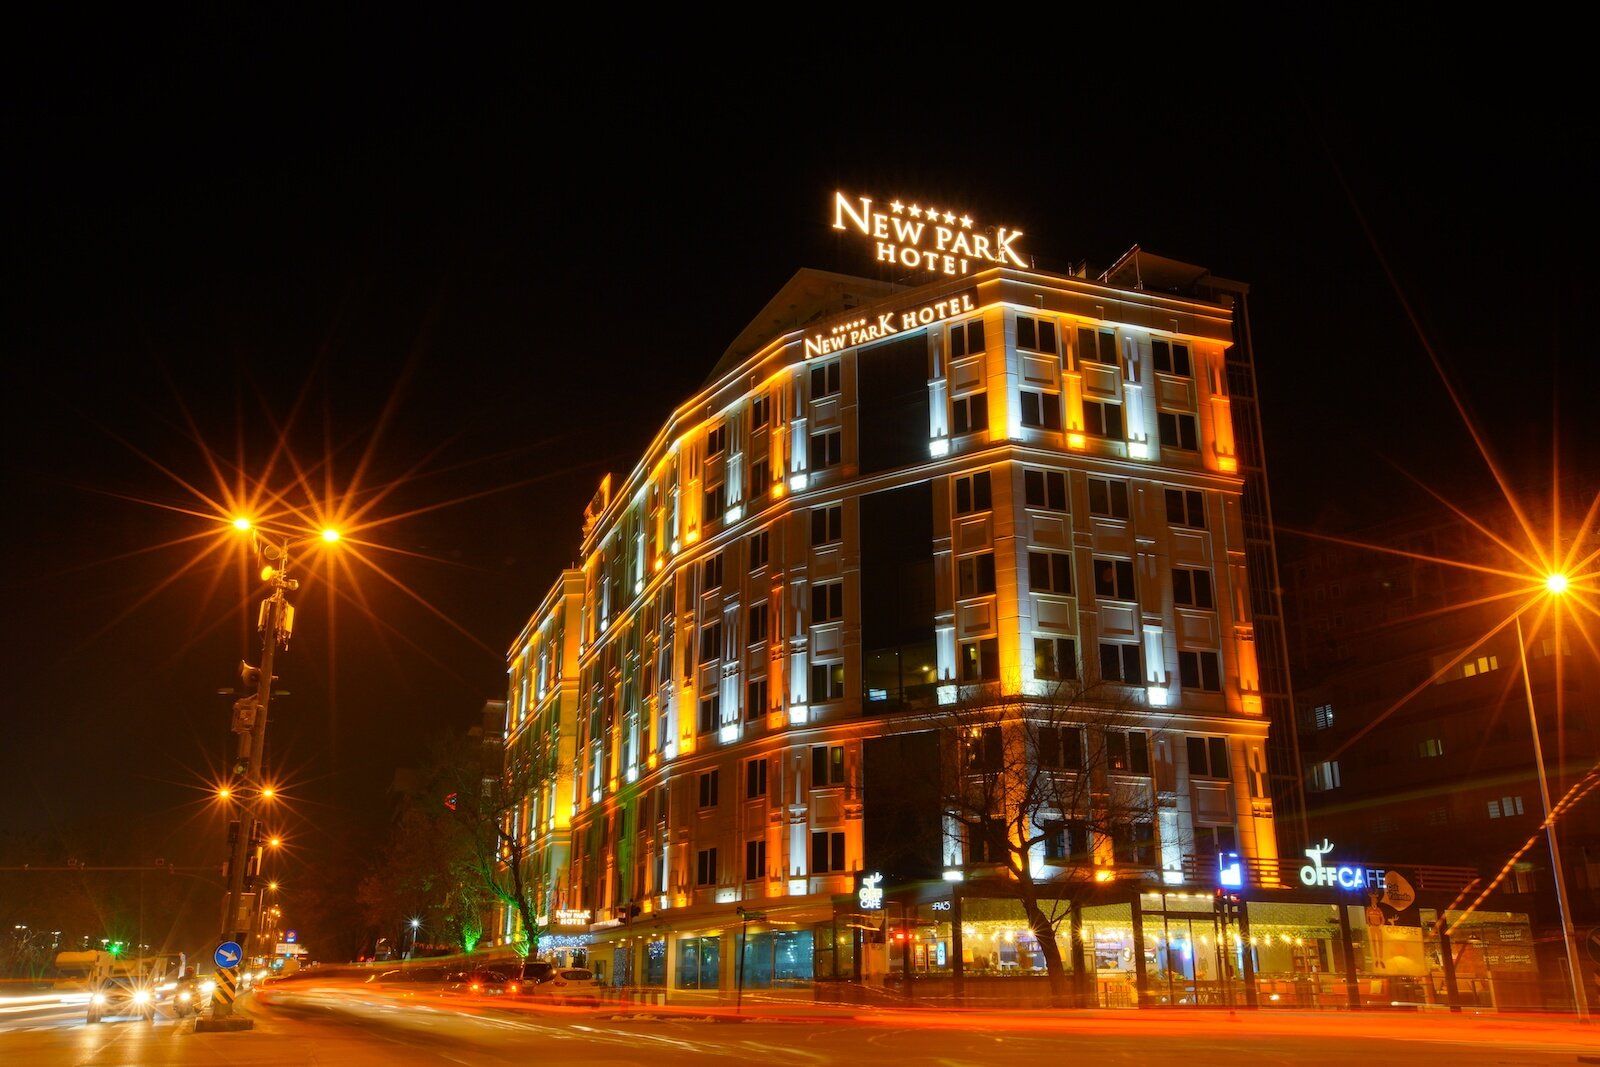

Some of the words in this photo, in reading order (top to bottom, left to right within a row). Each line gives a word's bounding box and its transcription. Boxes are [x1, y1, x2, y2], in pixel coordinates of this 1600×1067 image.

[832, 191, 925, 245] NEW
[935, 227, 1028, 268] PARK
[804, 334, 846, 359] NEW
[851, 312, 897, 345] PARK
[902, 294, 974, 329] HOTEL
[860, 900, 881, 908] CAFE
